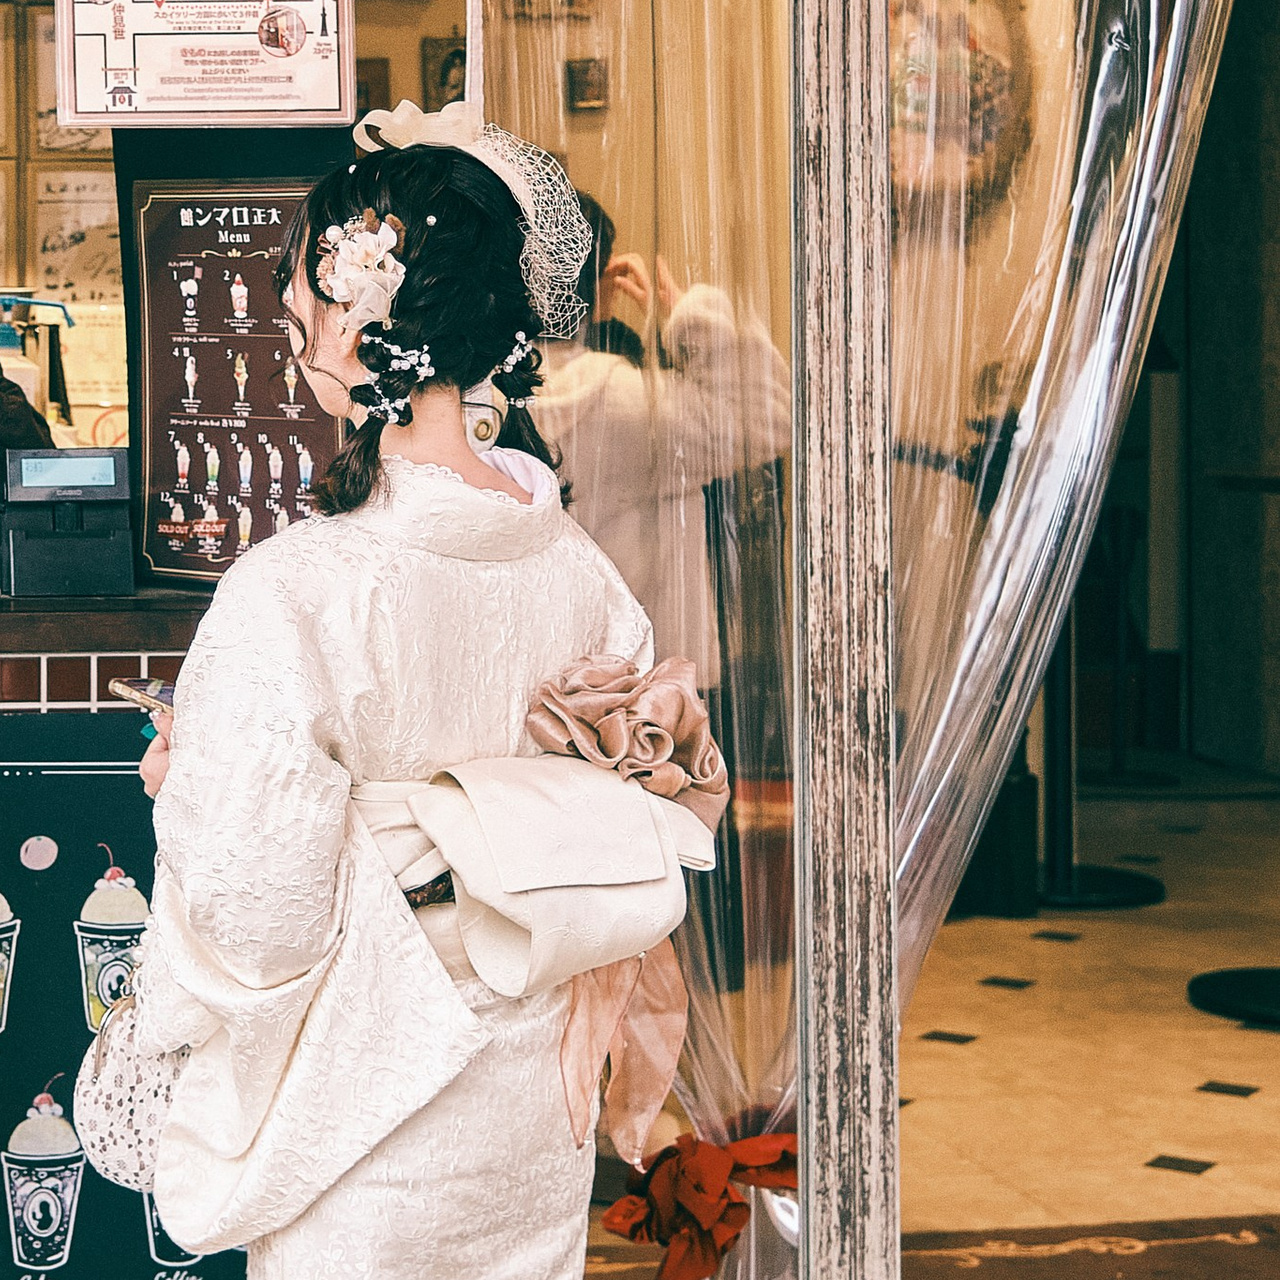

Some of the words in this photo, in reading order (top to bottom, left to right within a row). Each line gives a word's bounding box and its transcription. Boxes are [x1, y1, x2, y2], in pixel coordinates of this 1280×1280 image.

[111, 3, 126, 41] 仲見世
[218, 230, 251, 244] Menu
[224, 270, 231, 281] 2
[173, 347, 179, 357] 4
[227, 349, 233, 359] 5
[274, 350, 282, 361] 6
[168, 431, 176, 442] 7
[197, 433, 204, 443] 8
[231, 433, 238, 443] 9
[258, 434, 267, 444] 10
[289, 435, 298, 445] 11
[161, 492, 170, 502] 12
[194, 494, 203, 504] 13
[228, 496, 237, 505] 14
[266, 499, 275, 509] 15
